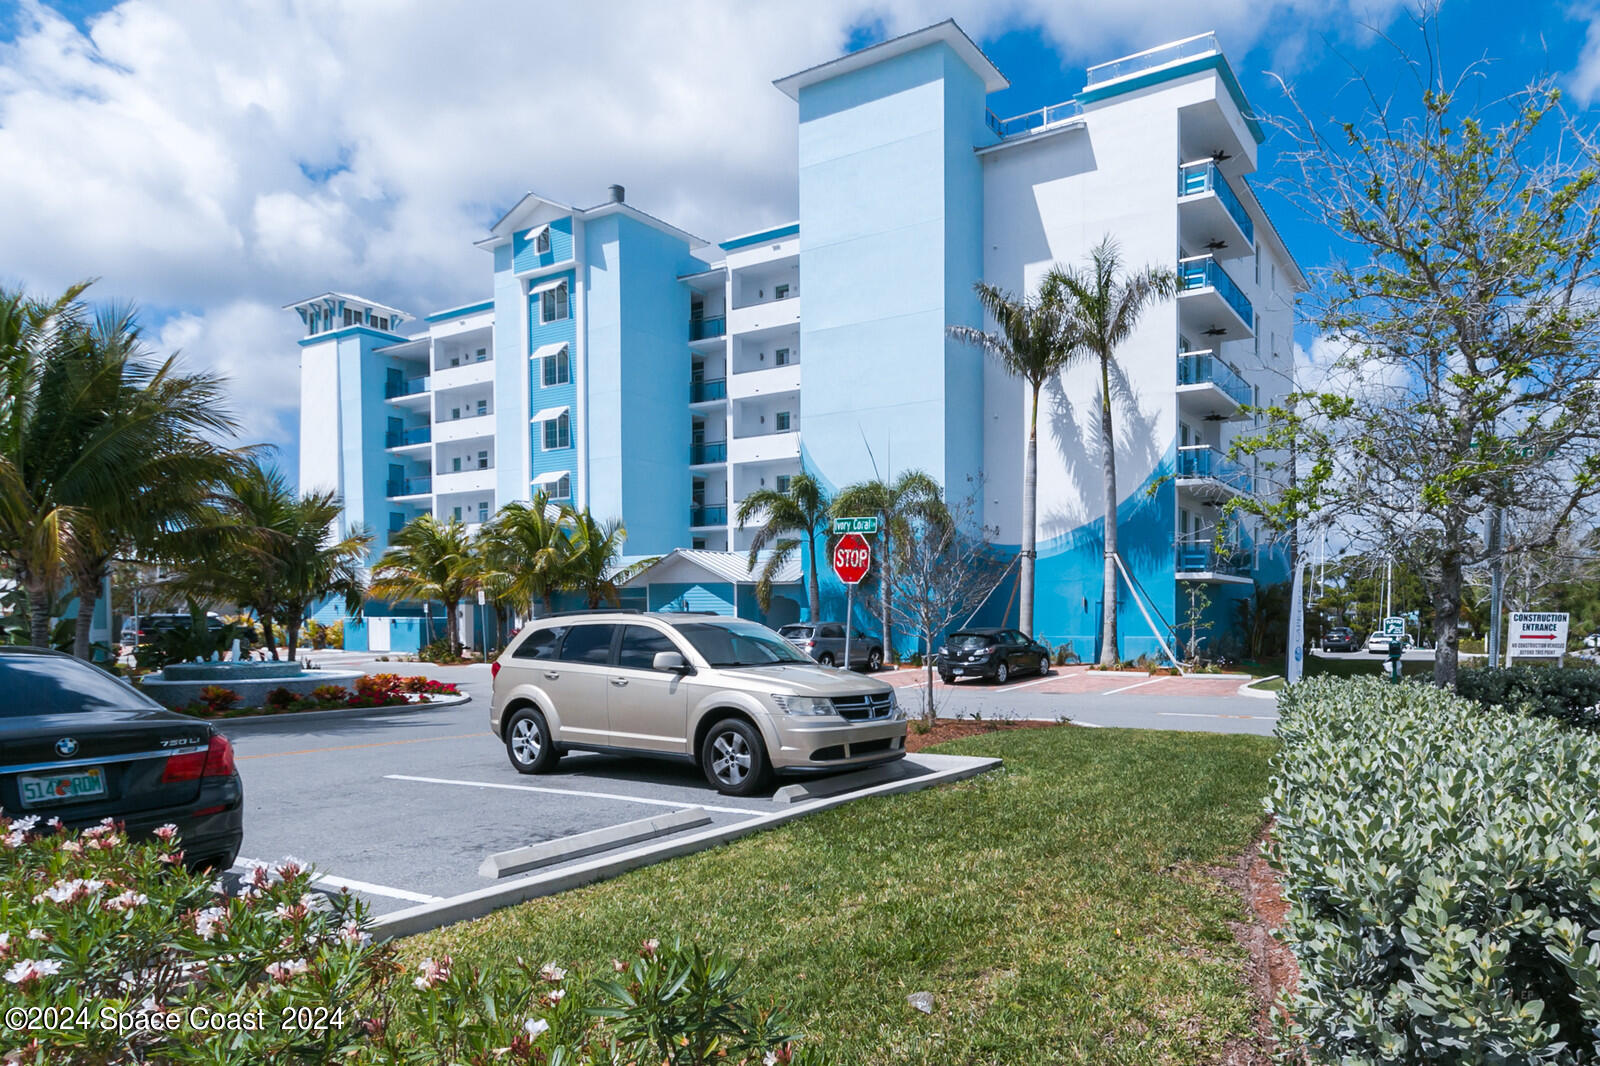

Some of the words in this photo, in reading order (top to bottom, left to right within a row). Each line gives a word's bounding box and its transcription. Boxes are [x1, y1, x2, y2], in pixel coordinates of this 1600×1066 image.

[853, 518, 871, 530] Coral
[836, 549, 868, 568] STOP
[1513, 613, 1568, 622] CONSTRUCTION
[1522, 623, 1558, 632] ENTRANCE
